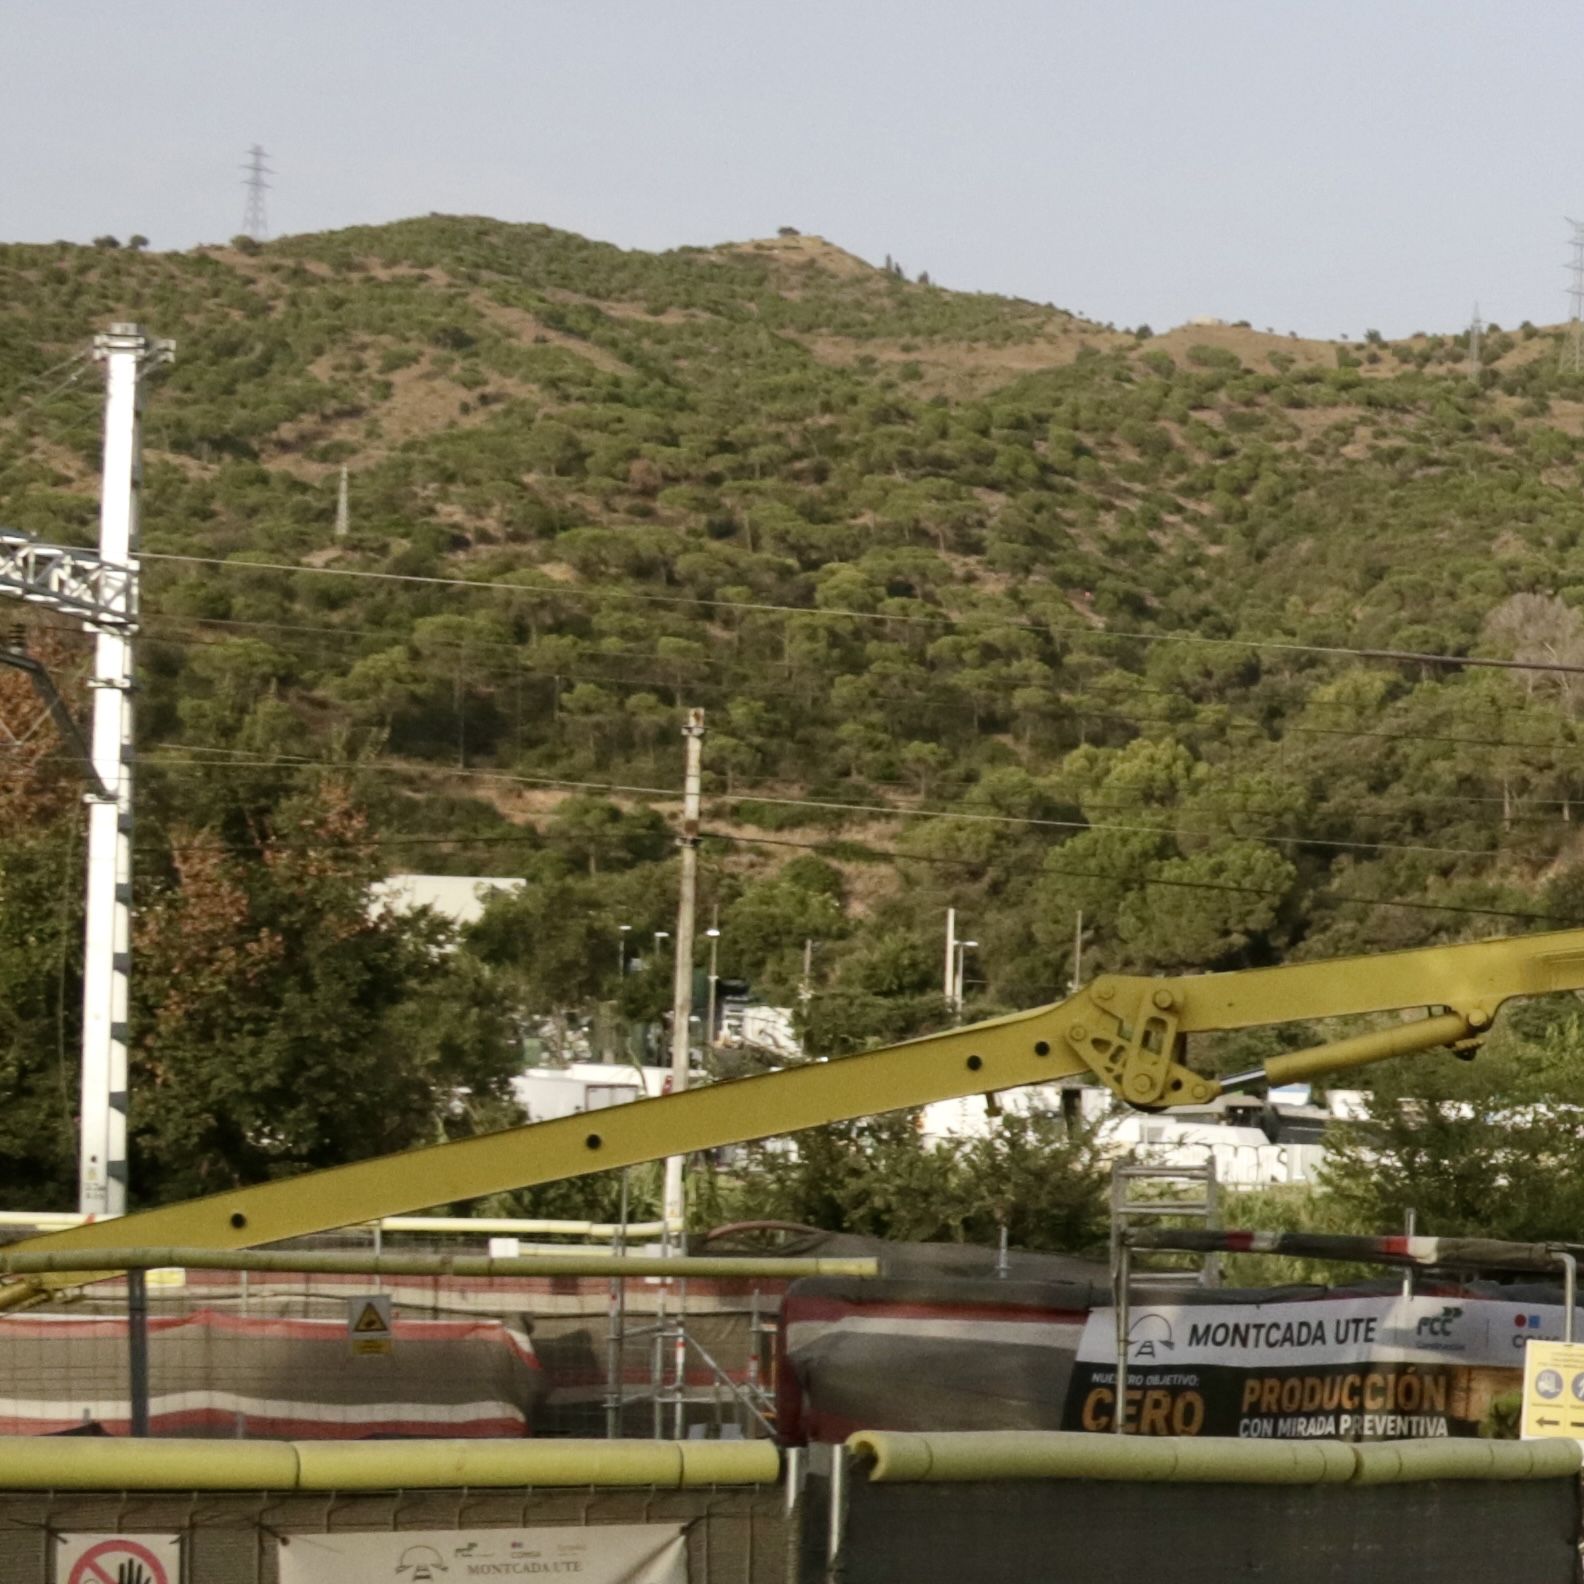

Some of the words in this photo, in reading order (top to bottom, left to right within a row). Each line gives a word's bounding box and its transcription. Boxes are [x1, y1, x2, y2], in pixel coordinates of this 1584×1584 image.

[1187, 1322, 1327, 1350] MONTCADA
[1334, 1317, 1379, 1345] UTE
[1091, 1372, 1143, 1386] NUERO
[1240, 1367, 1447, 1414] PRODUCCIÓN
[1082, 1388, 1205, 1436] CERO
[1239, 1418, 1273, 1438] CON
[1277, 1417, 1336, 1438] MIRADA
[1338, 1416, 1449, 1438] PREVENTIVA
[467, 1563, 551, 1576] MONTCADA
[553, 1561, 583, 1573] UTE
